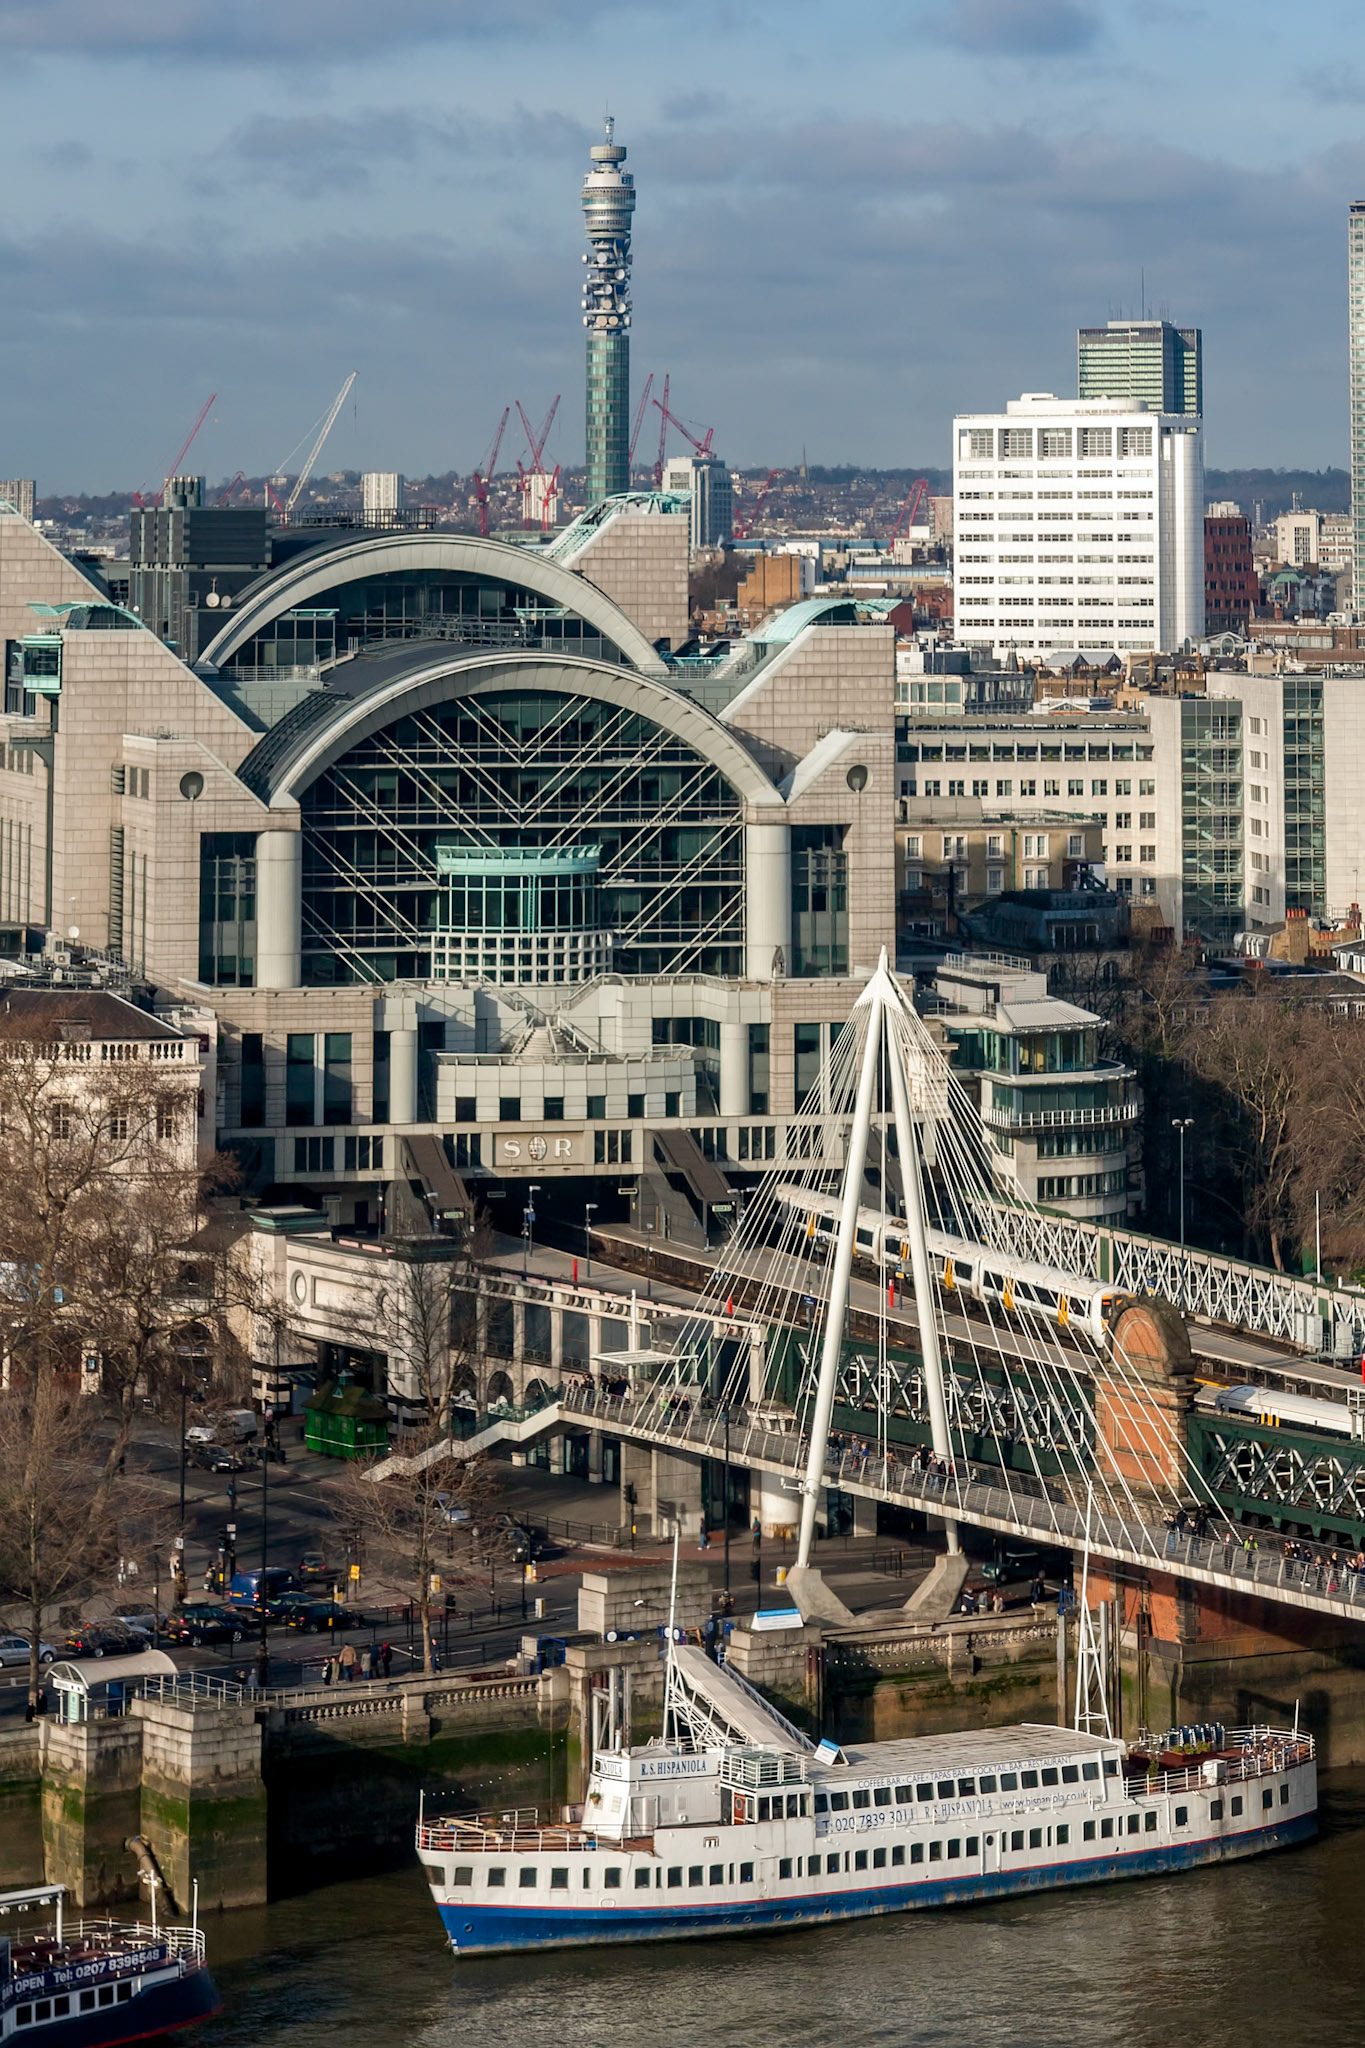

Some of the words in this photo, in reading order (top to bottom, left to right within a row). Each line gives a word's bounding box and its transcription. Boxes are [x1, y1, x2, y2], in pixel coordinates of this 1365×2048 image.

[657, 1760, 707, 1775] HISPANIOLA
[858, 1779, 885, 1789] COFFEE
[887, 1776, 902, 1786] BAR
[930, 1770, 951, 1781] TAPAS
[953, 1767, 967, 1777] BAR
[972, 1762, 1008, 1776] COCKTAIL
[1009, 1760, 1023, 1771] BAR
[1028, 1756, 1073, 1769] RESTAURANT
[835, 1817, 855, 1832] 020
[859, 1812, 885, 1828] 7839
[15, 1975, 45, 1994] OPEN
[53, 1970, 73, 1983] Tel:
[75, 1963, 106, 1979] 0207
[108, 1948, 160, 1971] 8396548
